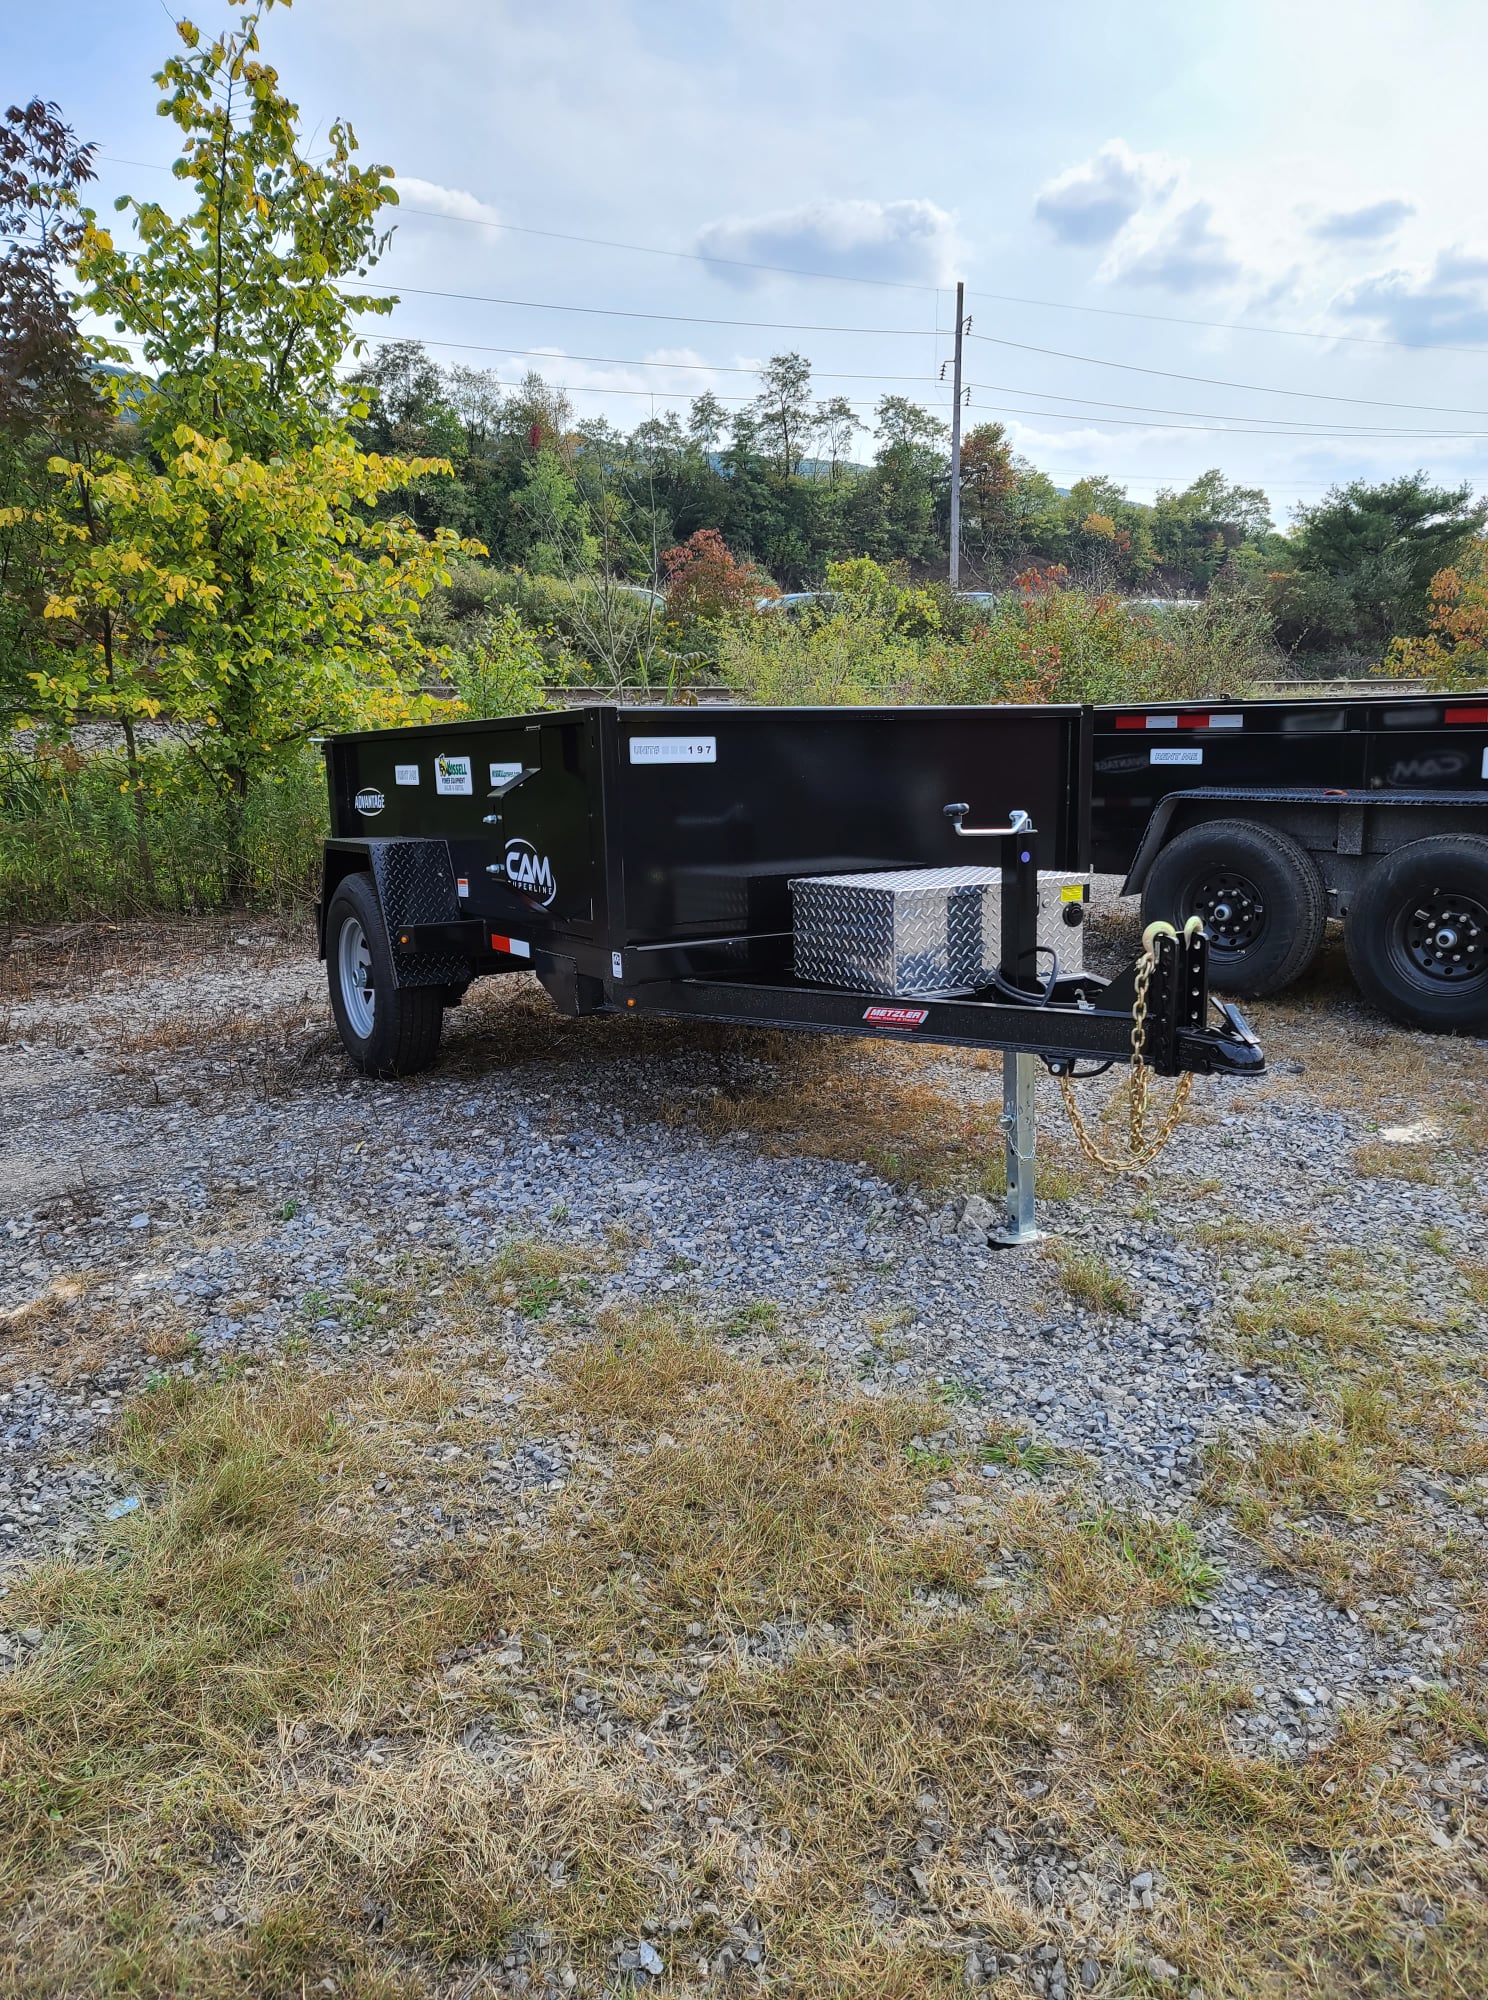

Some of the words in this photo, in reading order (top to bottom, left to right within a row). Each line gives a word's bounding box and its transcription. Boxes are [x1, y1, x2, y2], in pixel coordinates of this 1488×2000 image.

[1154, 752, 1181, 761] RENT
[1181, 752, 1198, 761] ME
[355, 794, 385, 809] ADVANTAGE
[506, 851, 552, 887] CAM
[508, 880, 553, 895] UPERLINE
[870, 1008, 922, 1019] METZLER
